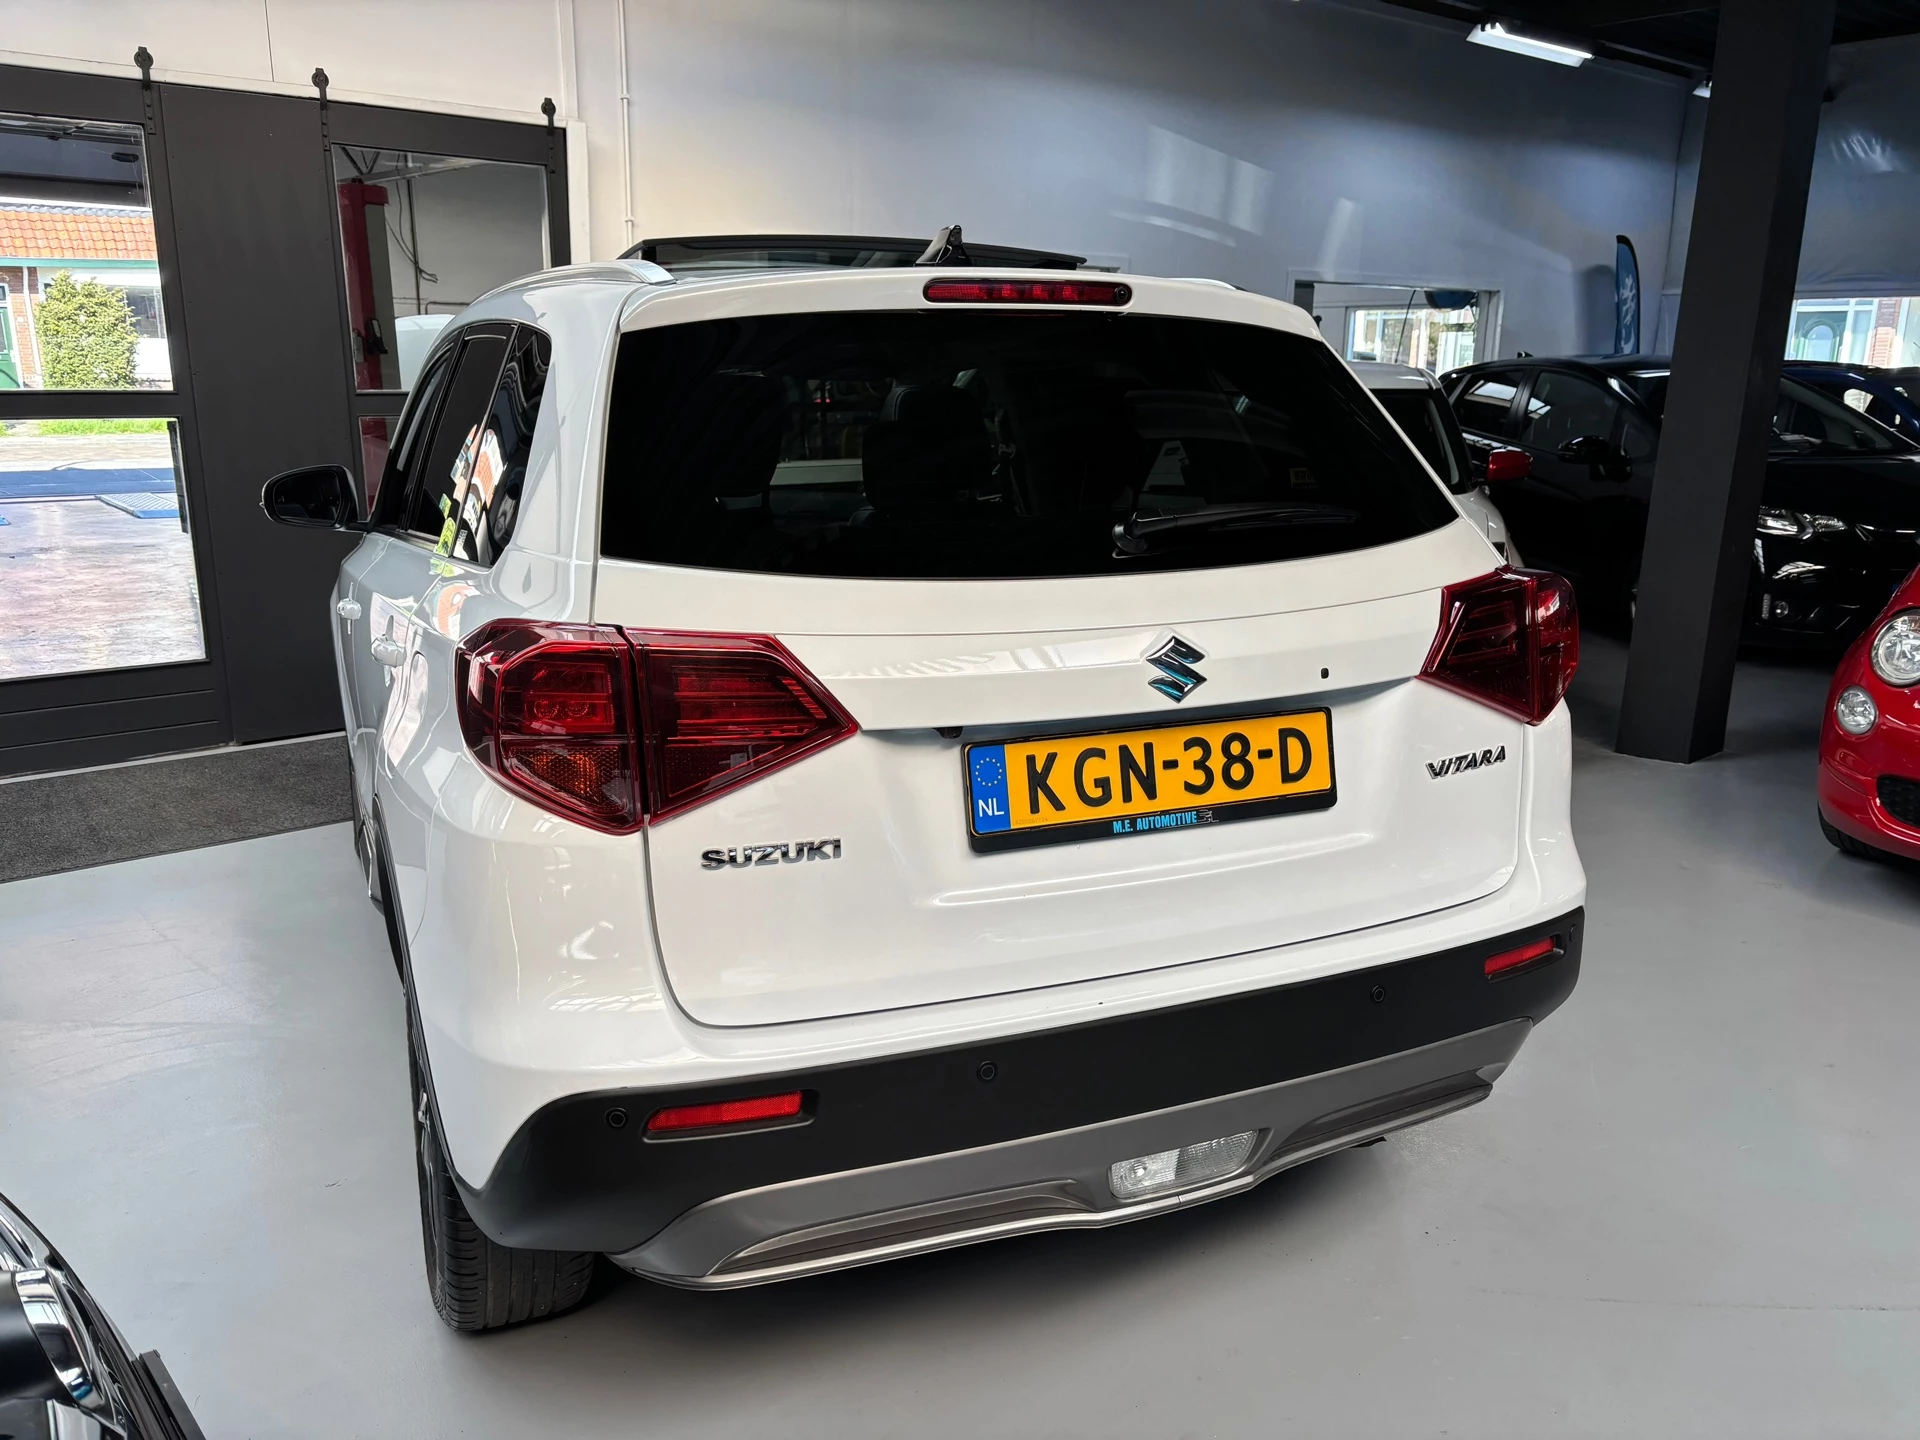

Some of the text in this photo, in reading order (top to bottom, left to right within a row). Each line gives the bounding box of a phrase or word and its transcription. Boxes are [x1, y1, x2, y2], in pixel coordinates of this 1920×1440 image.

[1025, 727, 1312, 815] KGN-38-D
[1425, 745, 1506, 779] VITARA
[978, 797, 1005, 817] NL
[1113, 811, 1197, 833] M.E. AUTOMOTIVE
[701, 838, 842, 870] SUZUKI
